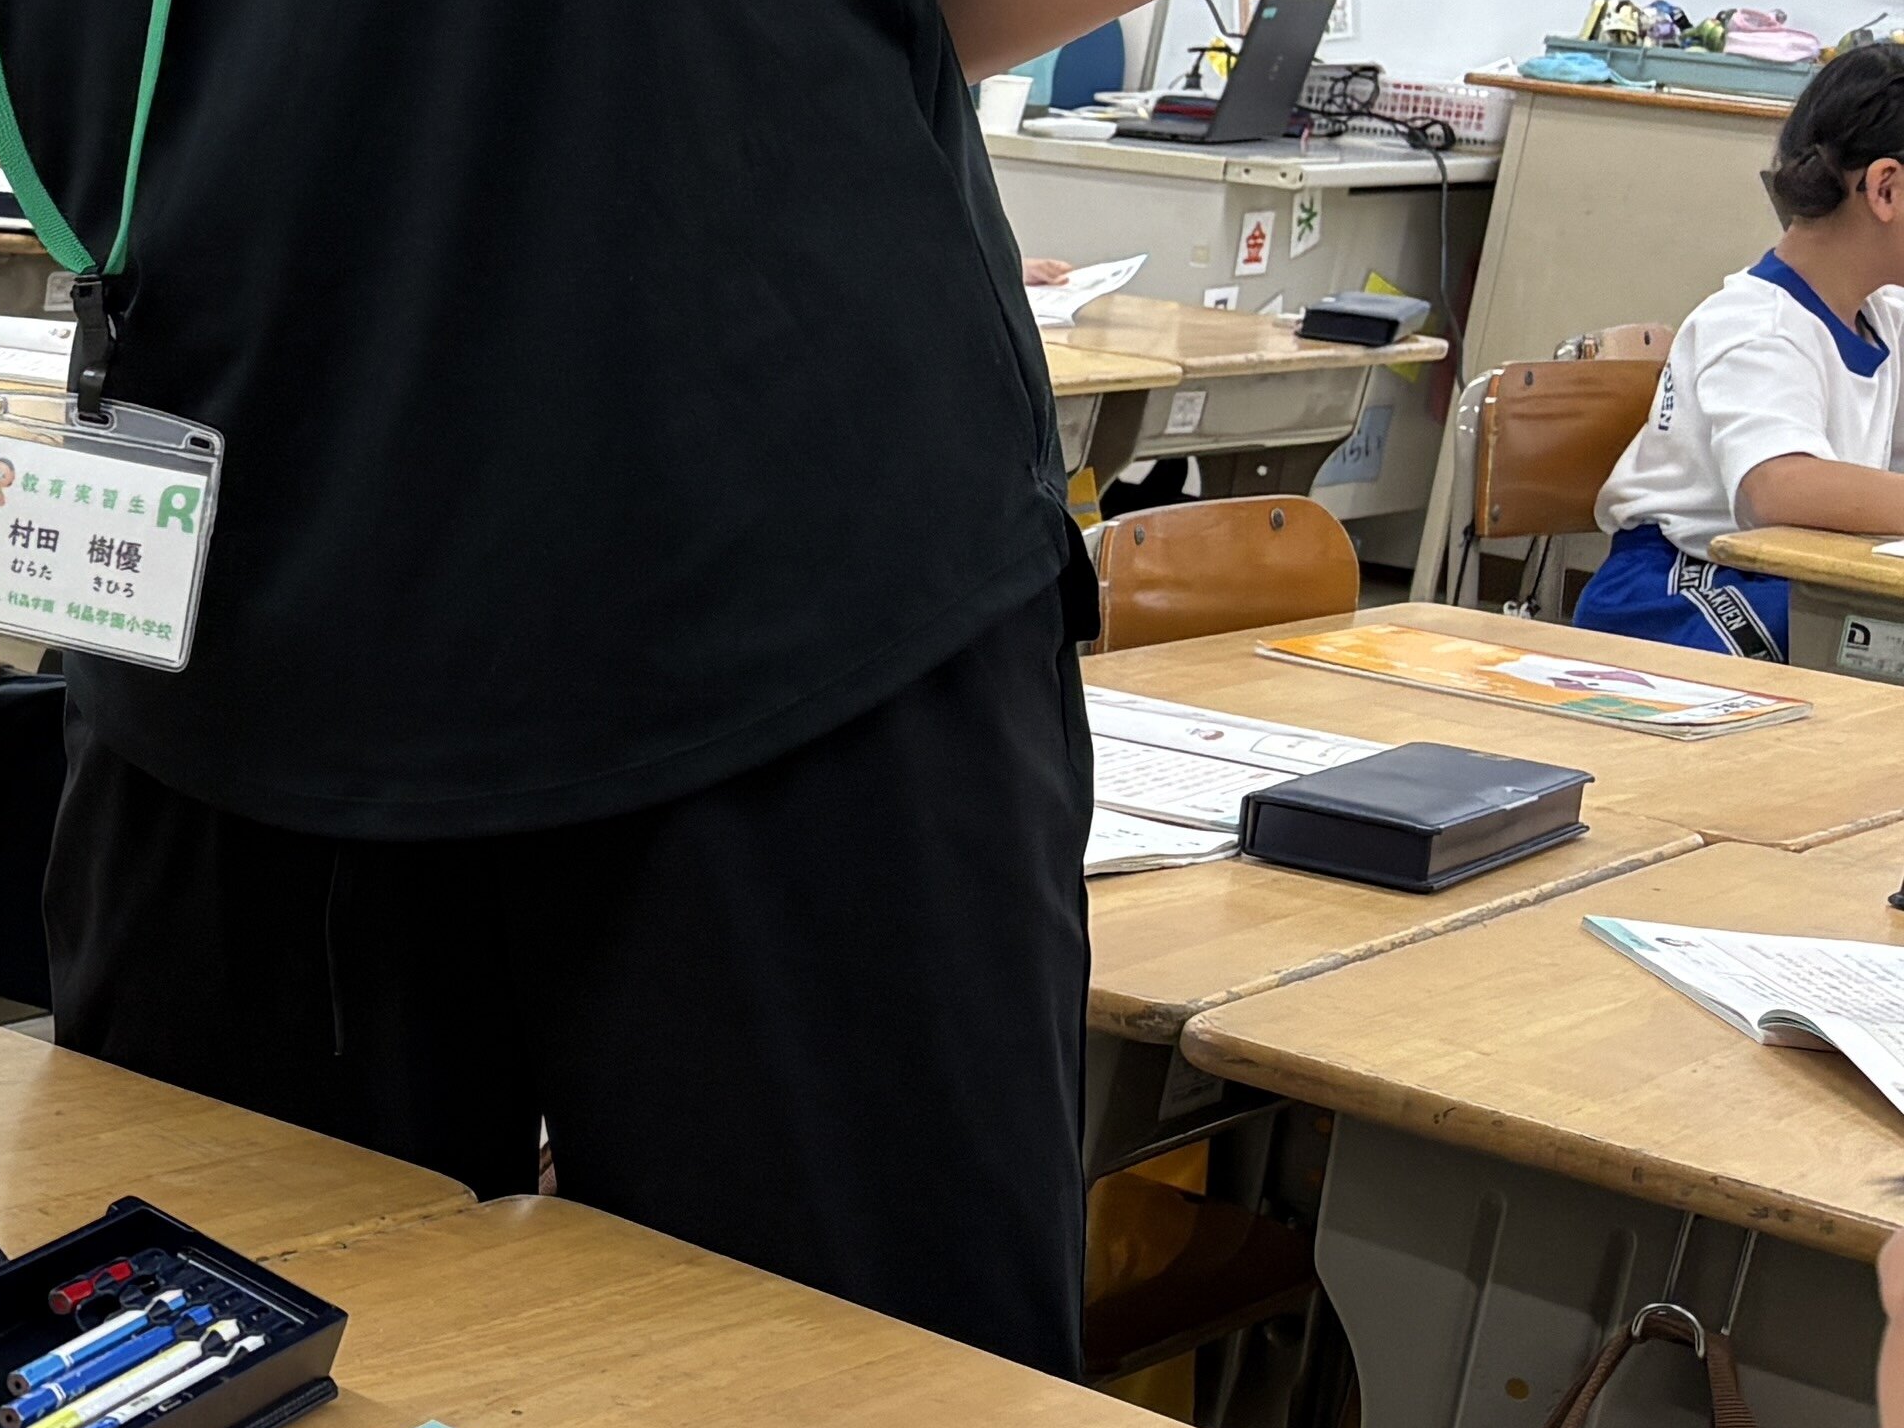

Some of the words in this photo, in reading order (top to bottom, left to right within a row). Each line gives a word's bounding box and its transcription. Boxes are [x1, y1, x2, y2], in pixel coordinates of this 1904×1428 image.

[20, 472, 146, 515] 教育実習生
[8, 518, 60, 552] 村田
[87, 533, 143, 573] 樹優
[11, 558, 53, 580] むらた
[92, 576, 135, 598] きひろ
